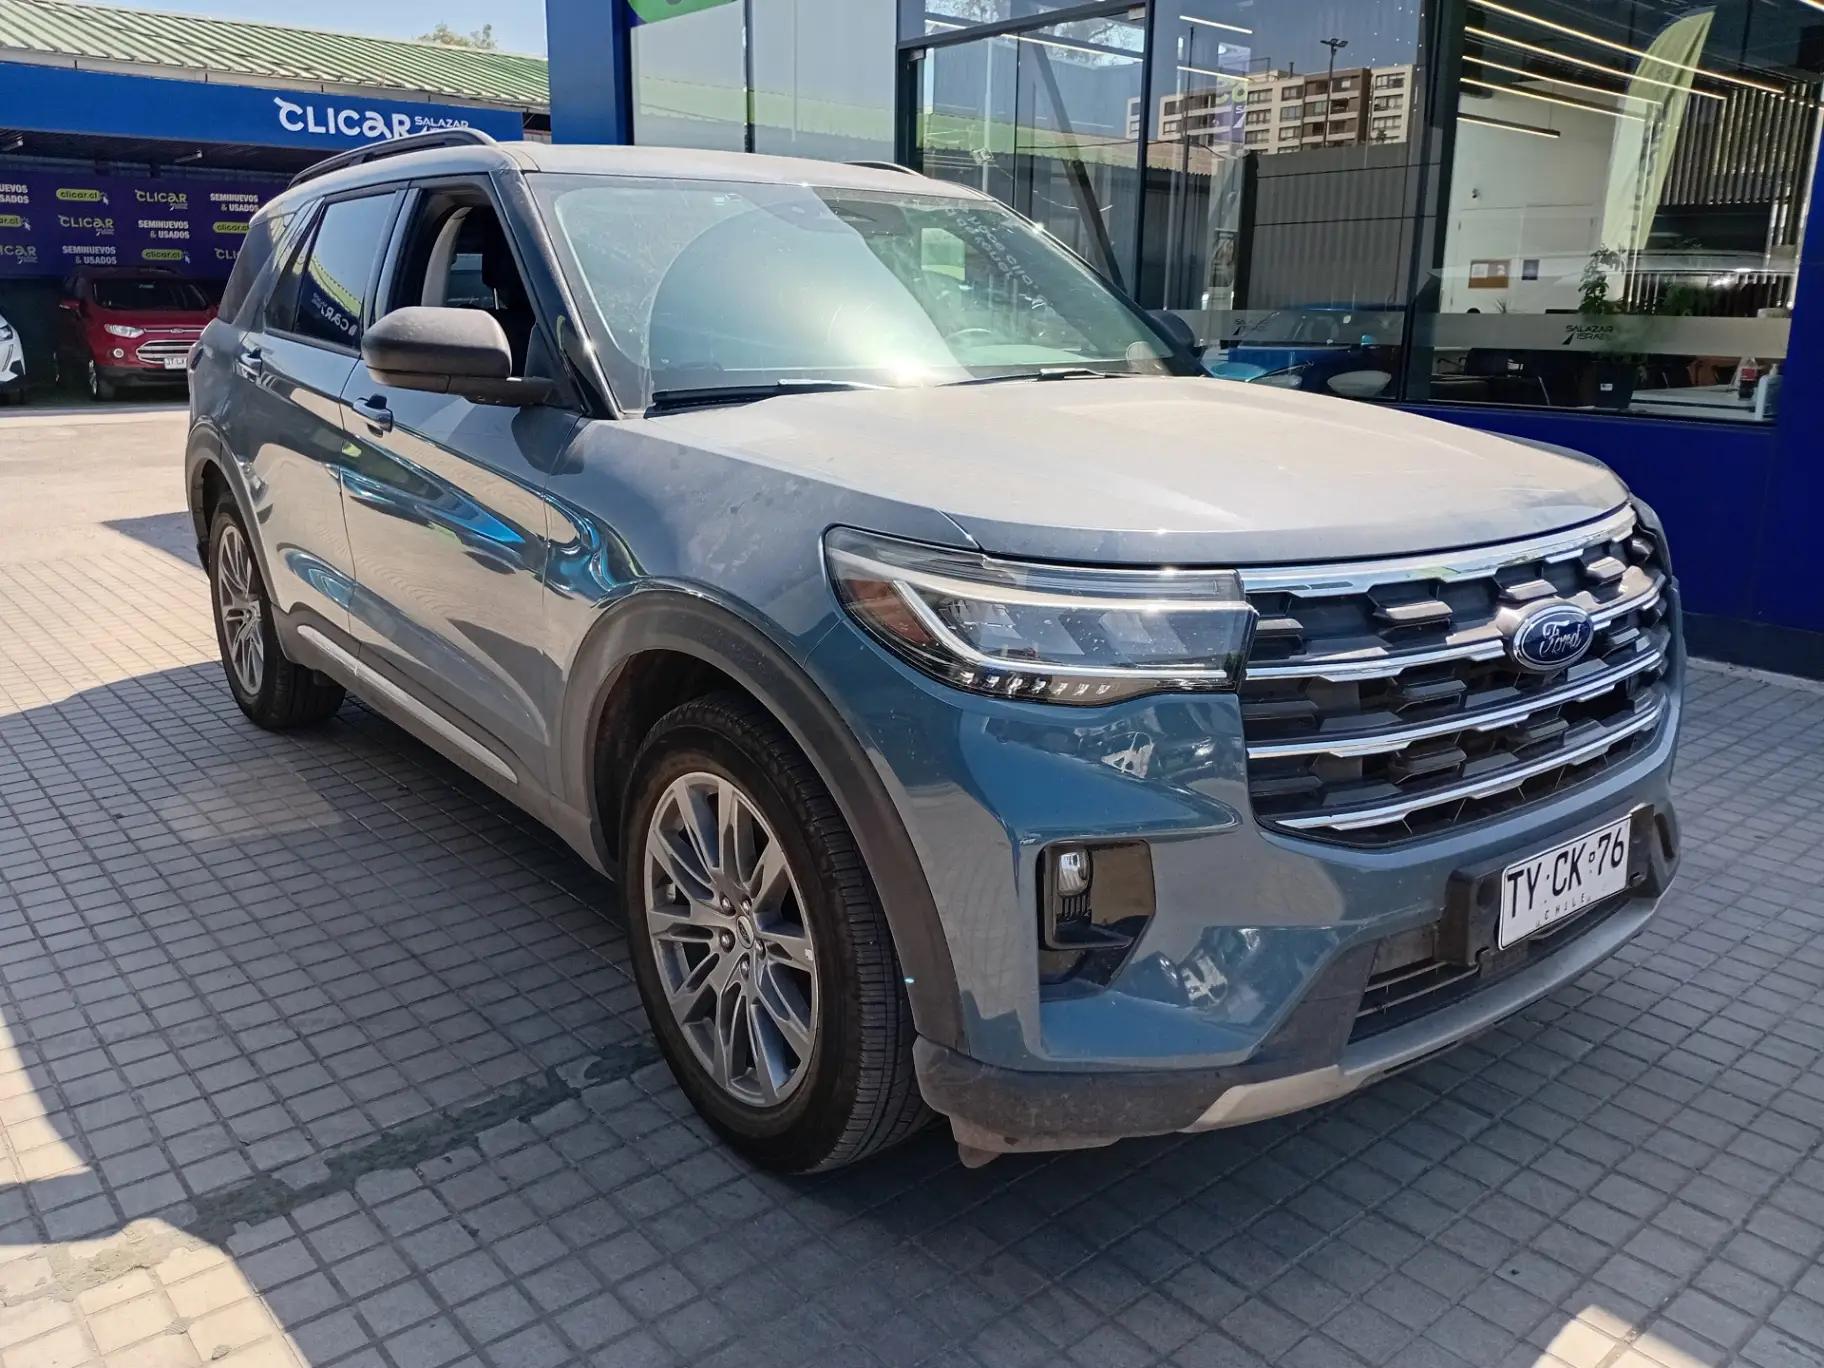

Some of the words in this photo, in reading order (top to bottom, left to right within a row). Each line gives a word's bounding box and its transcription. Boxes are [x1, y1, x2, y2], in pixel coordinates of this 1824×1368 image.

[414, 116, 469, 128] SALAZAR
[210, 193, 259, 202] SEMINUEVOS
[138, 219, 189, 229] SEMINUEVOS
[158, 230, 190, 239] USADOS
[62, 245, 116, 255] SEMINUEVOS
[83, 256, 117, 265] USADOS
[1539, 620, 1584, 657] Ford
[1544, 893, 1586, 921] CHILE
